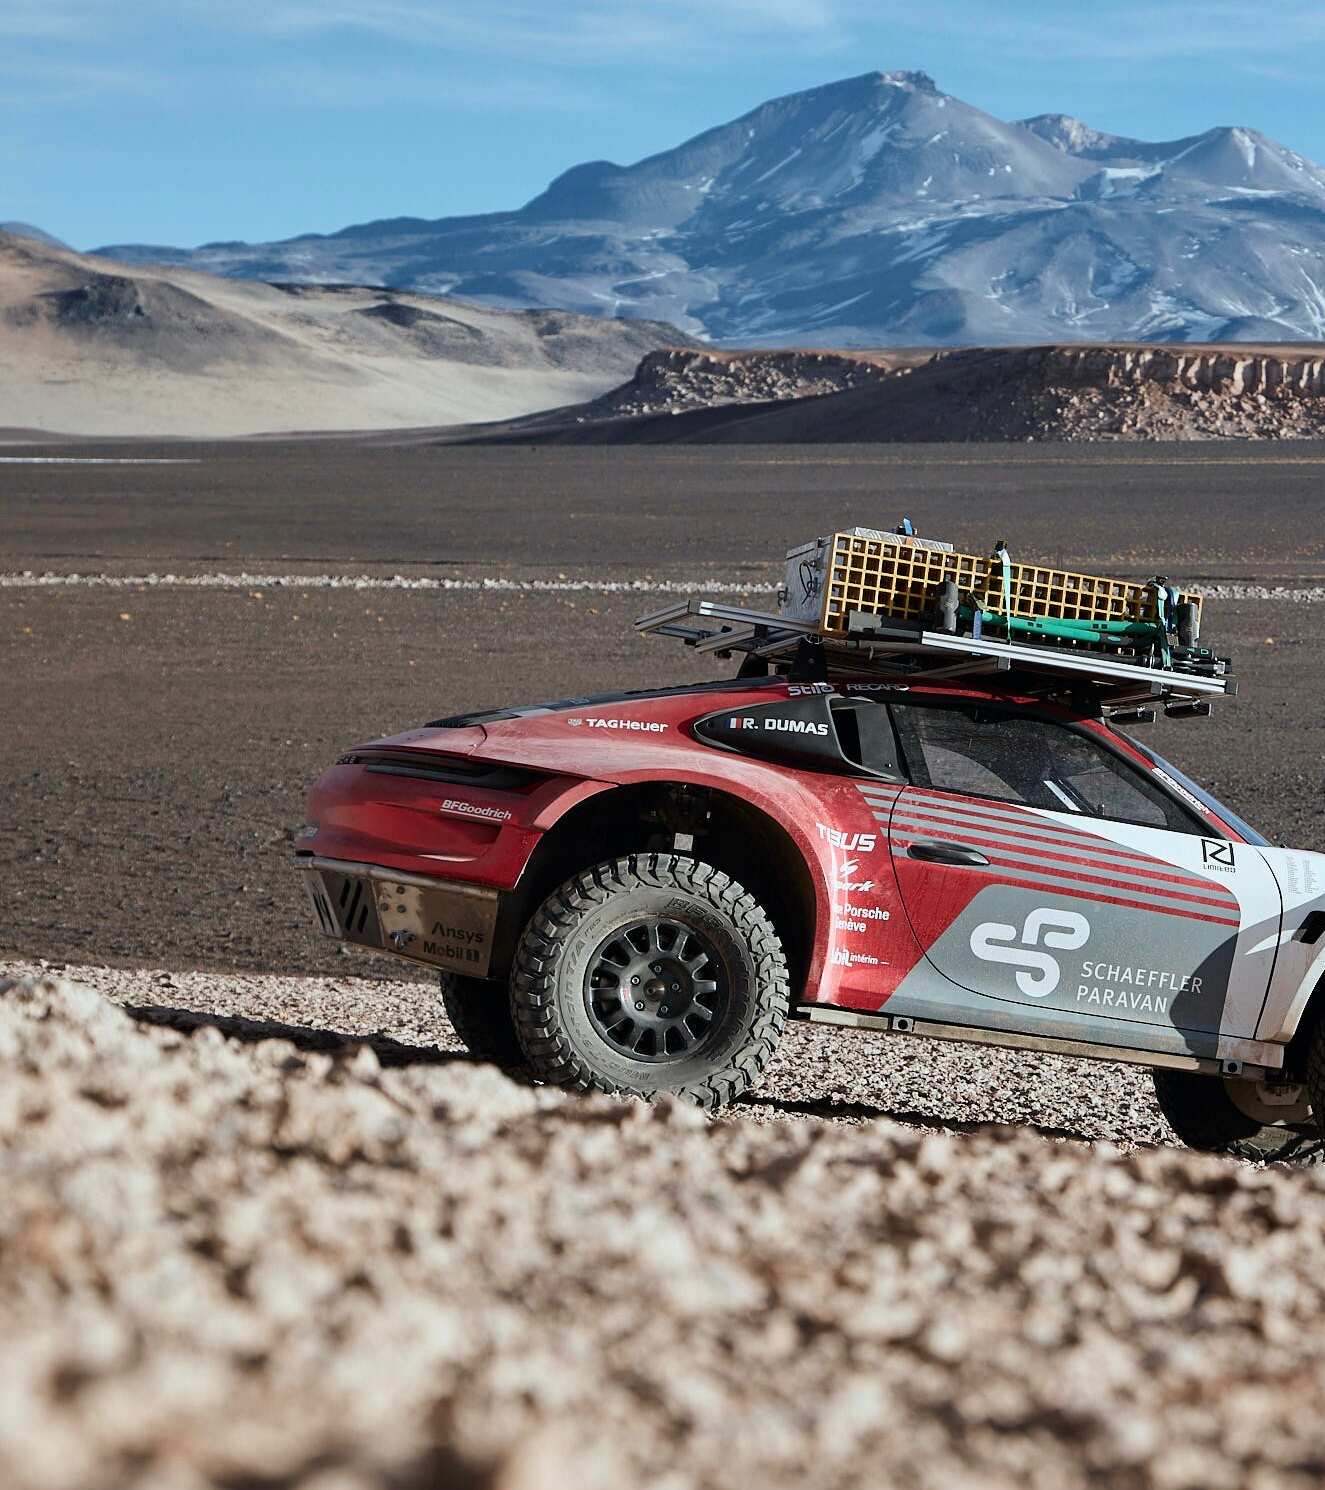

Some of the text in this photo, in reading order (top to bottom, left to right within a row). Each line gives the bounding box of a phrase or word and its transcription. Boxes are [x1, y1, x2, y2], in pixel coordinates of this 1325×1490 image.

[743, 717, 829, 736] R. DUMAS
[441, 799, 512, 822] BFGoodrich
[844, 903, 890, 921] Porsche
[432, 922, 484, 943] Ansys
[424, 941, 463, 960] Mobil
[1080, 961, 1203, 994] SCHAEFFLER
[1076, 985, 1168, 1013] PARAVAN
